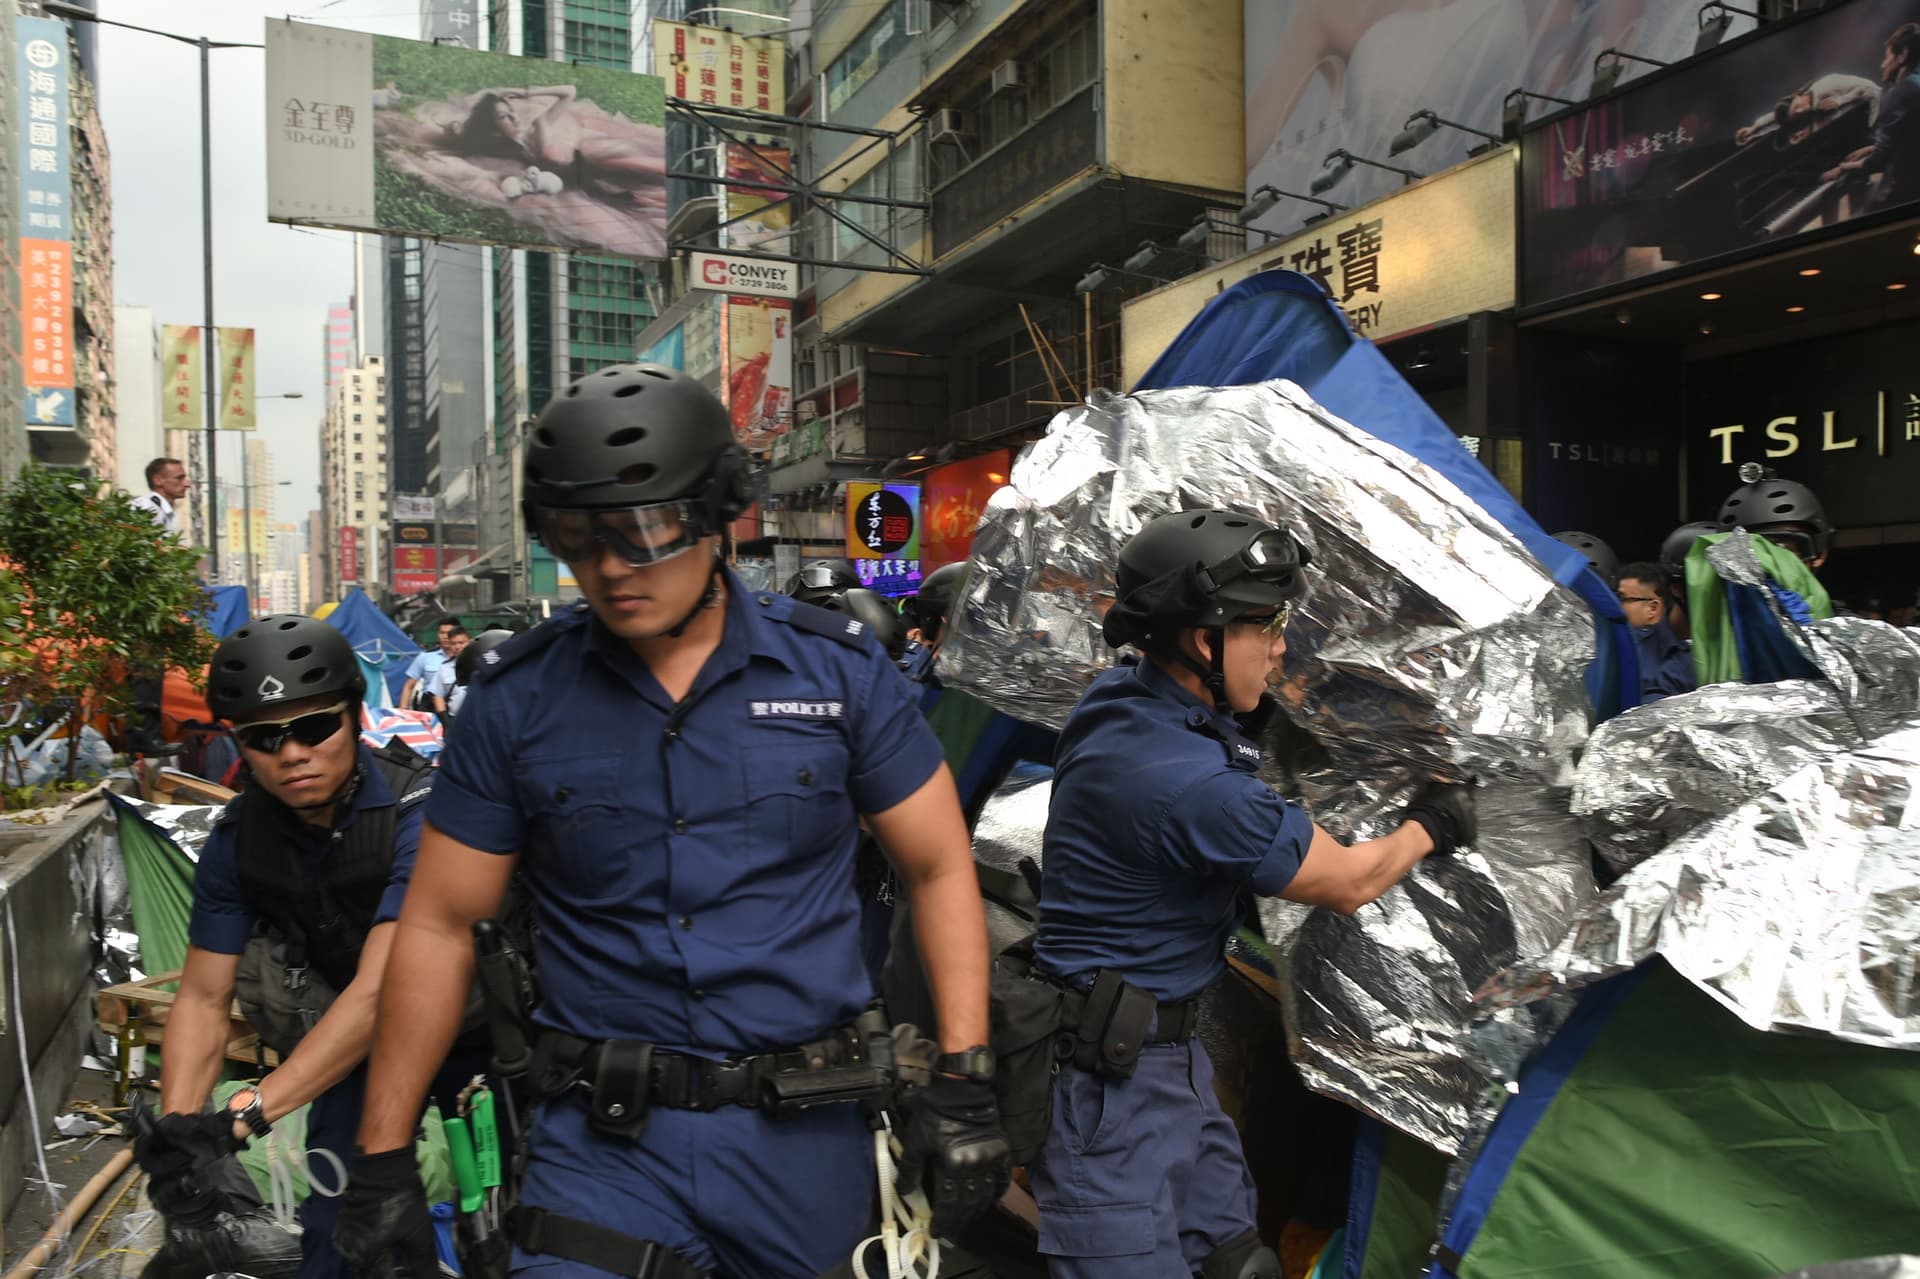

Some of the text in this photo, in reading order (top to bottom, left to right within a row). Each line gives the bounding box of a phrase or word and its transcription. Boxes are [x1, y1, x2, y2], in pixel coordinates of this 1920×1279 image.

[27, 70, 58, 173] 海通國際
[284, 98, 356, 134] 金至尊
[728, 263, 788, 280] CONVEY
[1709, 411, 1858, 464] TSL
[770, 702, 827, 715] POLICE
